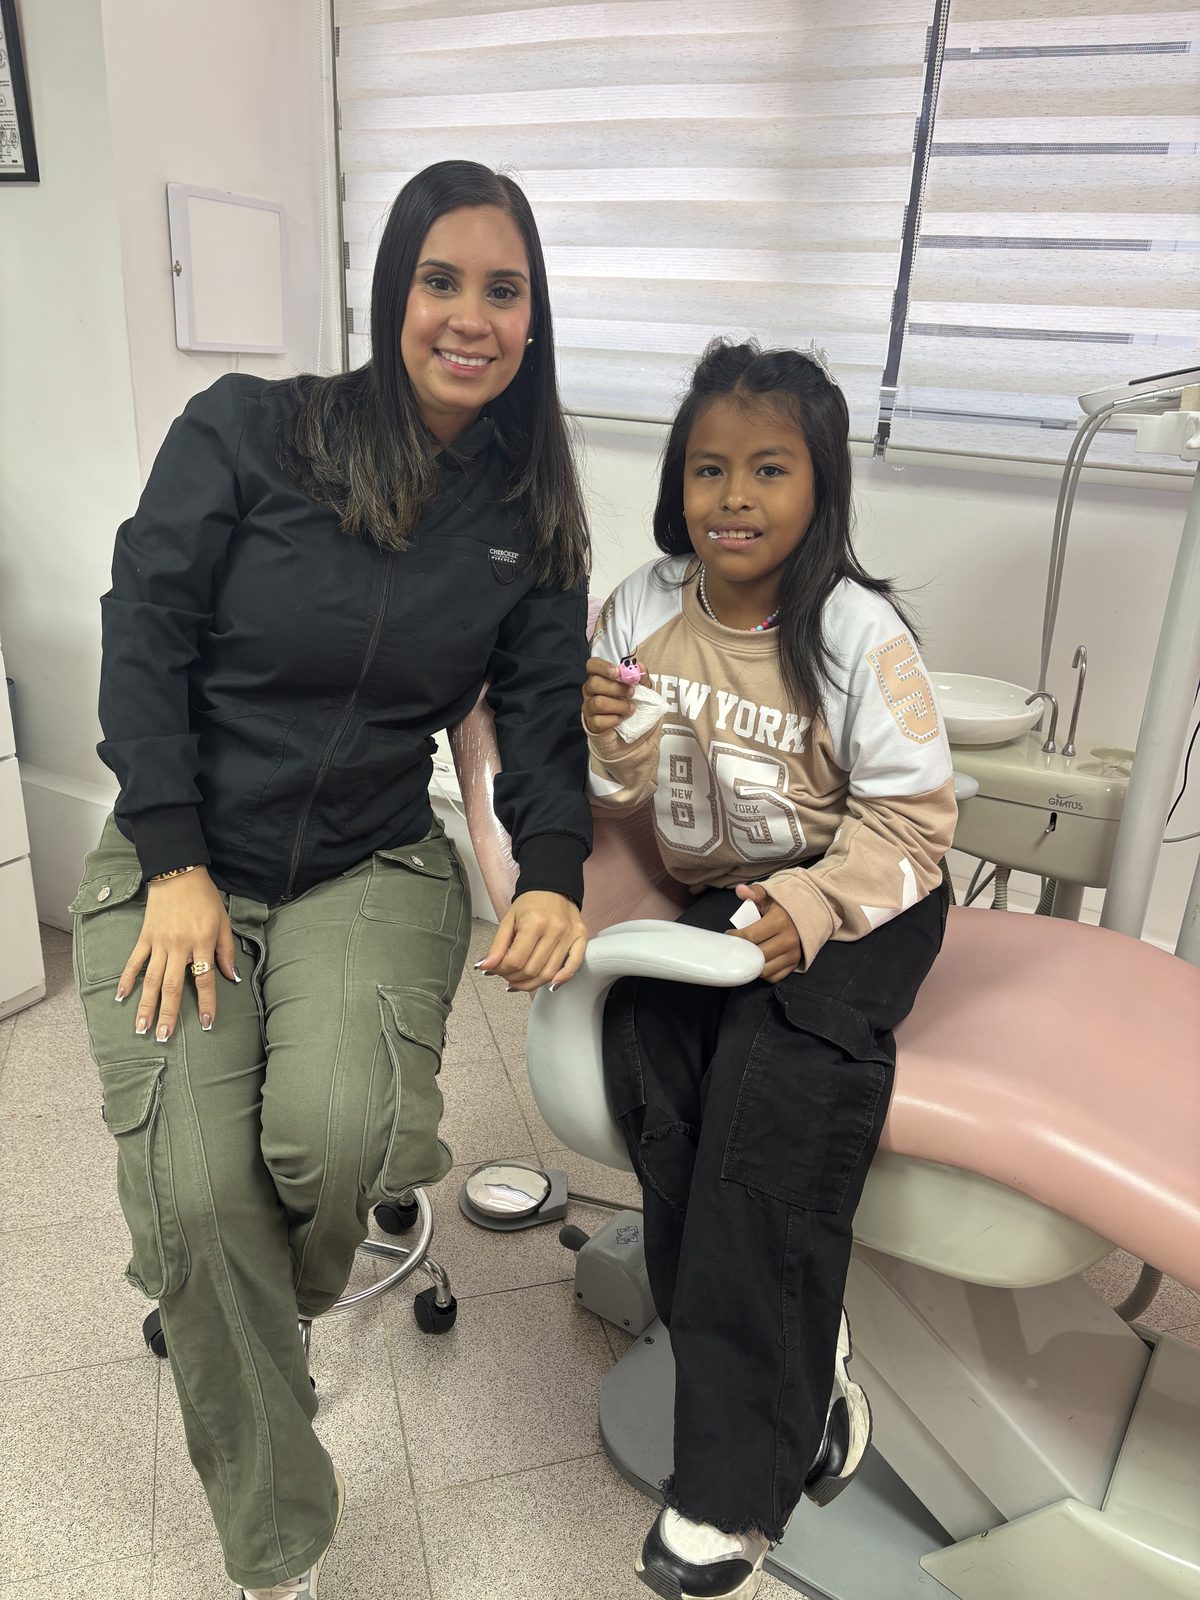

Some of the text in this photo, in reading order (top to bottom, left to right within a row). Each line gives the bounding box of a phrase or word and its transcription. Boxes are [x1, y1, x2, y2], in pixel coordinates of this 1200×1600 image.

[865, 633, 940, 744] 5
[715, 690, 812, 754] YORK
[671, 788, 760, 814] NEW YORK
[1048, 797, 1083, 811] GNATUS
